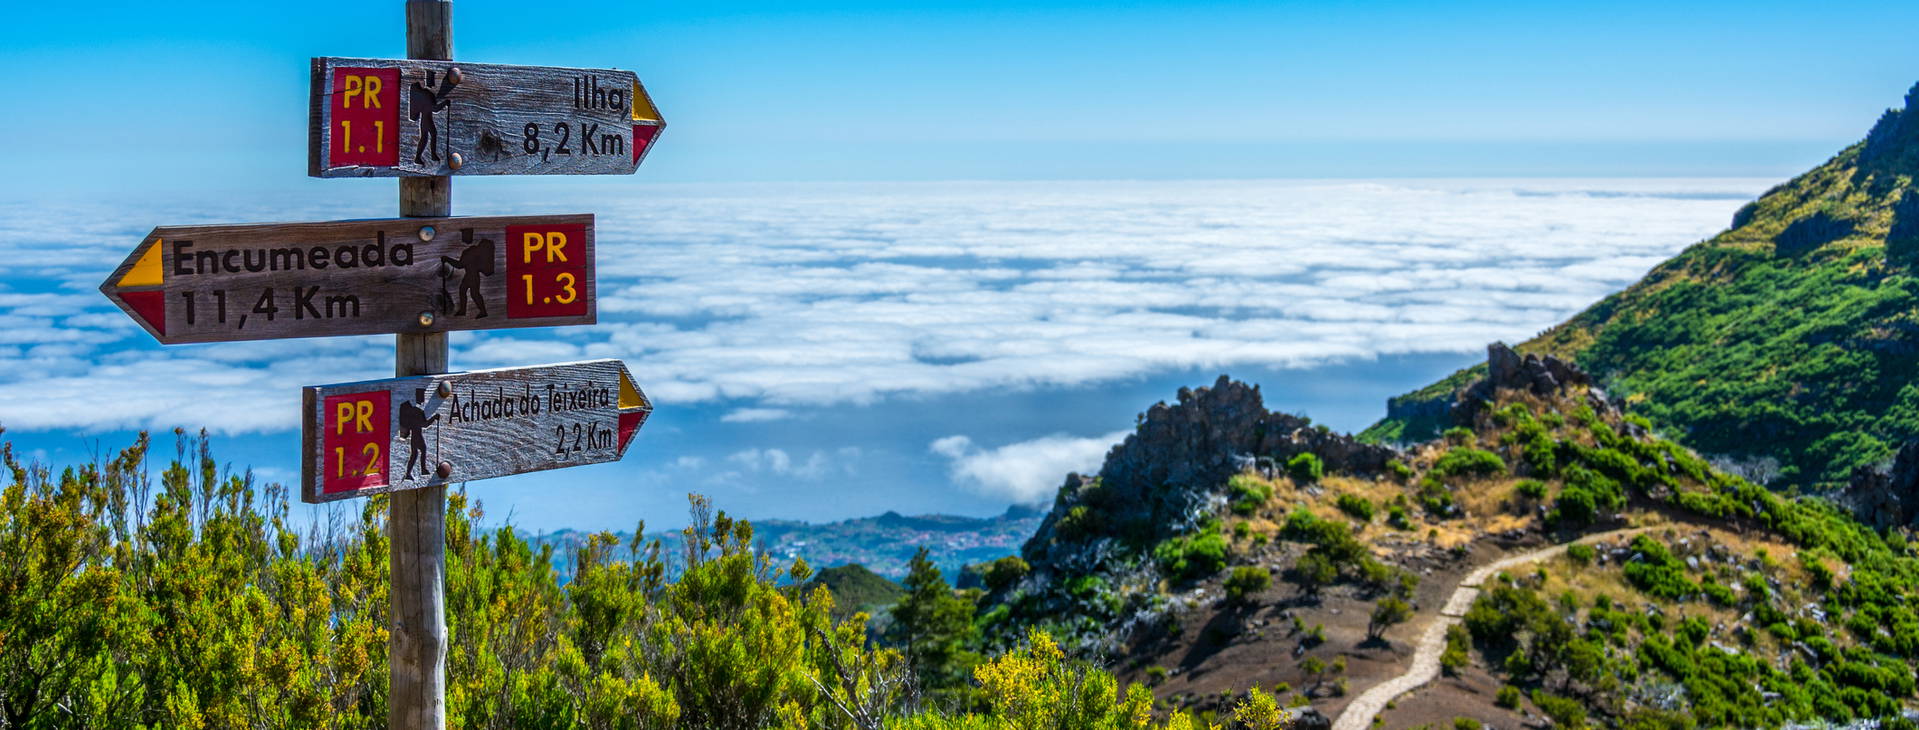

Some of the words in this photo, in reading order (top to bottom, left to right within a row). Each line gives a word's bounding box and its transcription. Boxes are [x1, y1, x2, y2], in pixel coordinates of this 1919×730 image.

[343, 75, 382, 109] PR
[341, 120, 383, 153] 1.1
[523, 122, 571, 162] 8,2
[582, 123, 624, 155] Km
[172, 231, 414, 276] Encumeada
[523, 231, 568, 264] PR
[522, 272, 577, 306] 1.3
[181, 289, 279, 330] 11,4
[295, 287, 360, 320] Km
[336, 400, 374, 435] PR
[449, 387, 514, 425] Achada
[520, 388, 541, 416] do
[546, 380, 610, 412] Teixeira
[555, 423, 583, 459] 2,2
[588, 420, 612, 451] Km
[335, 442, 382, 478] 1.2
